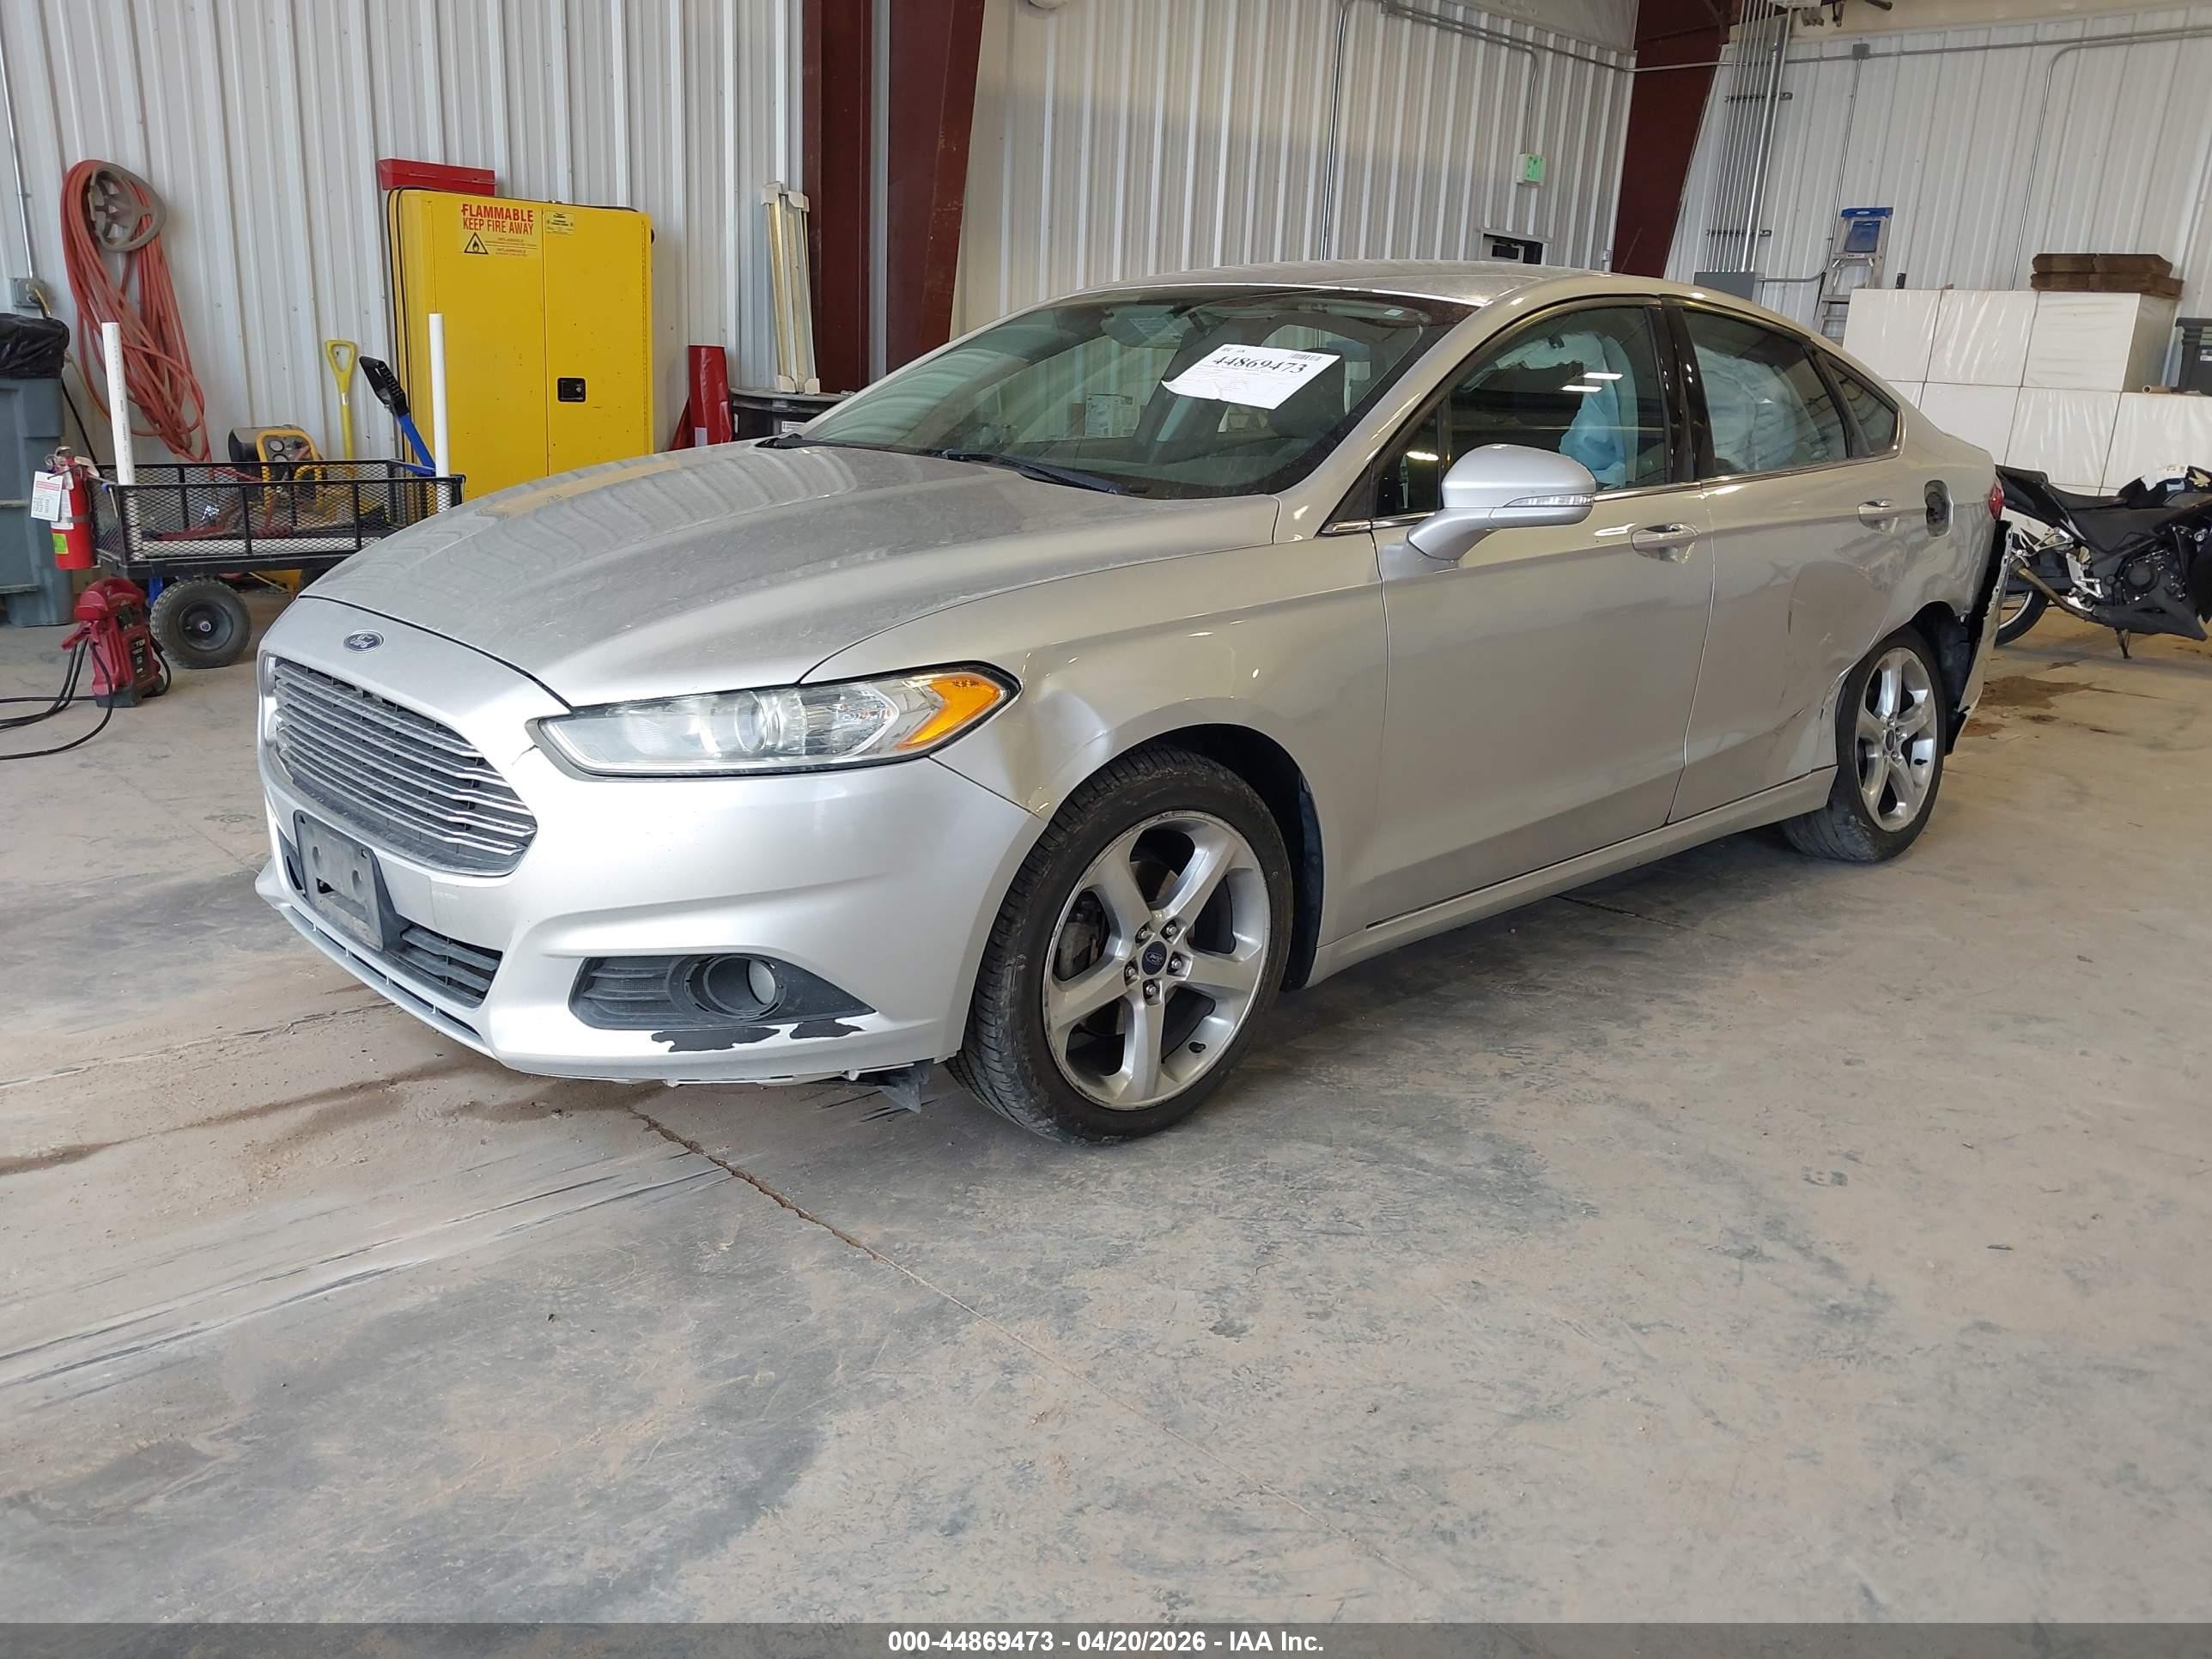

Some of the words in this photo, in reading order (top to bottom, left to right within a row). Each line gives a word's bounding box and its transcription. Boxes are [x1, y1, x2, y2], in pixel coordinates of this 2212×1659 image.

[462, 204, 534, 222] FLAMMABLE
[463, 217, 484, 231] KEEP
[487, 220, 507, 234] FIRE
[508, 222, 534, 235] AWAY
[1212, 356, 1309, 374] 44869473
